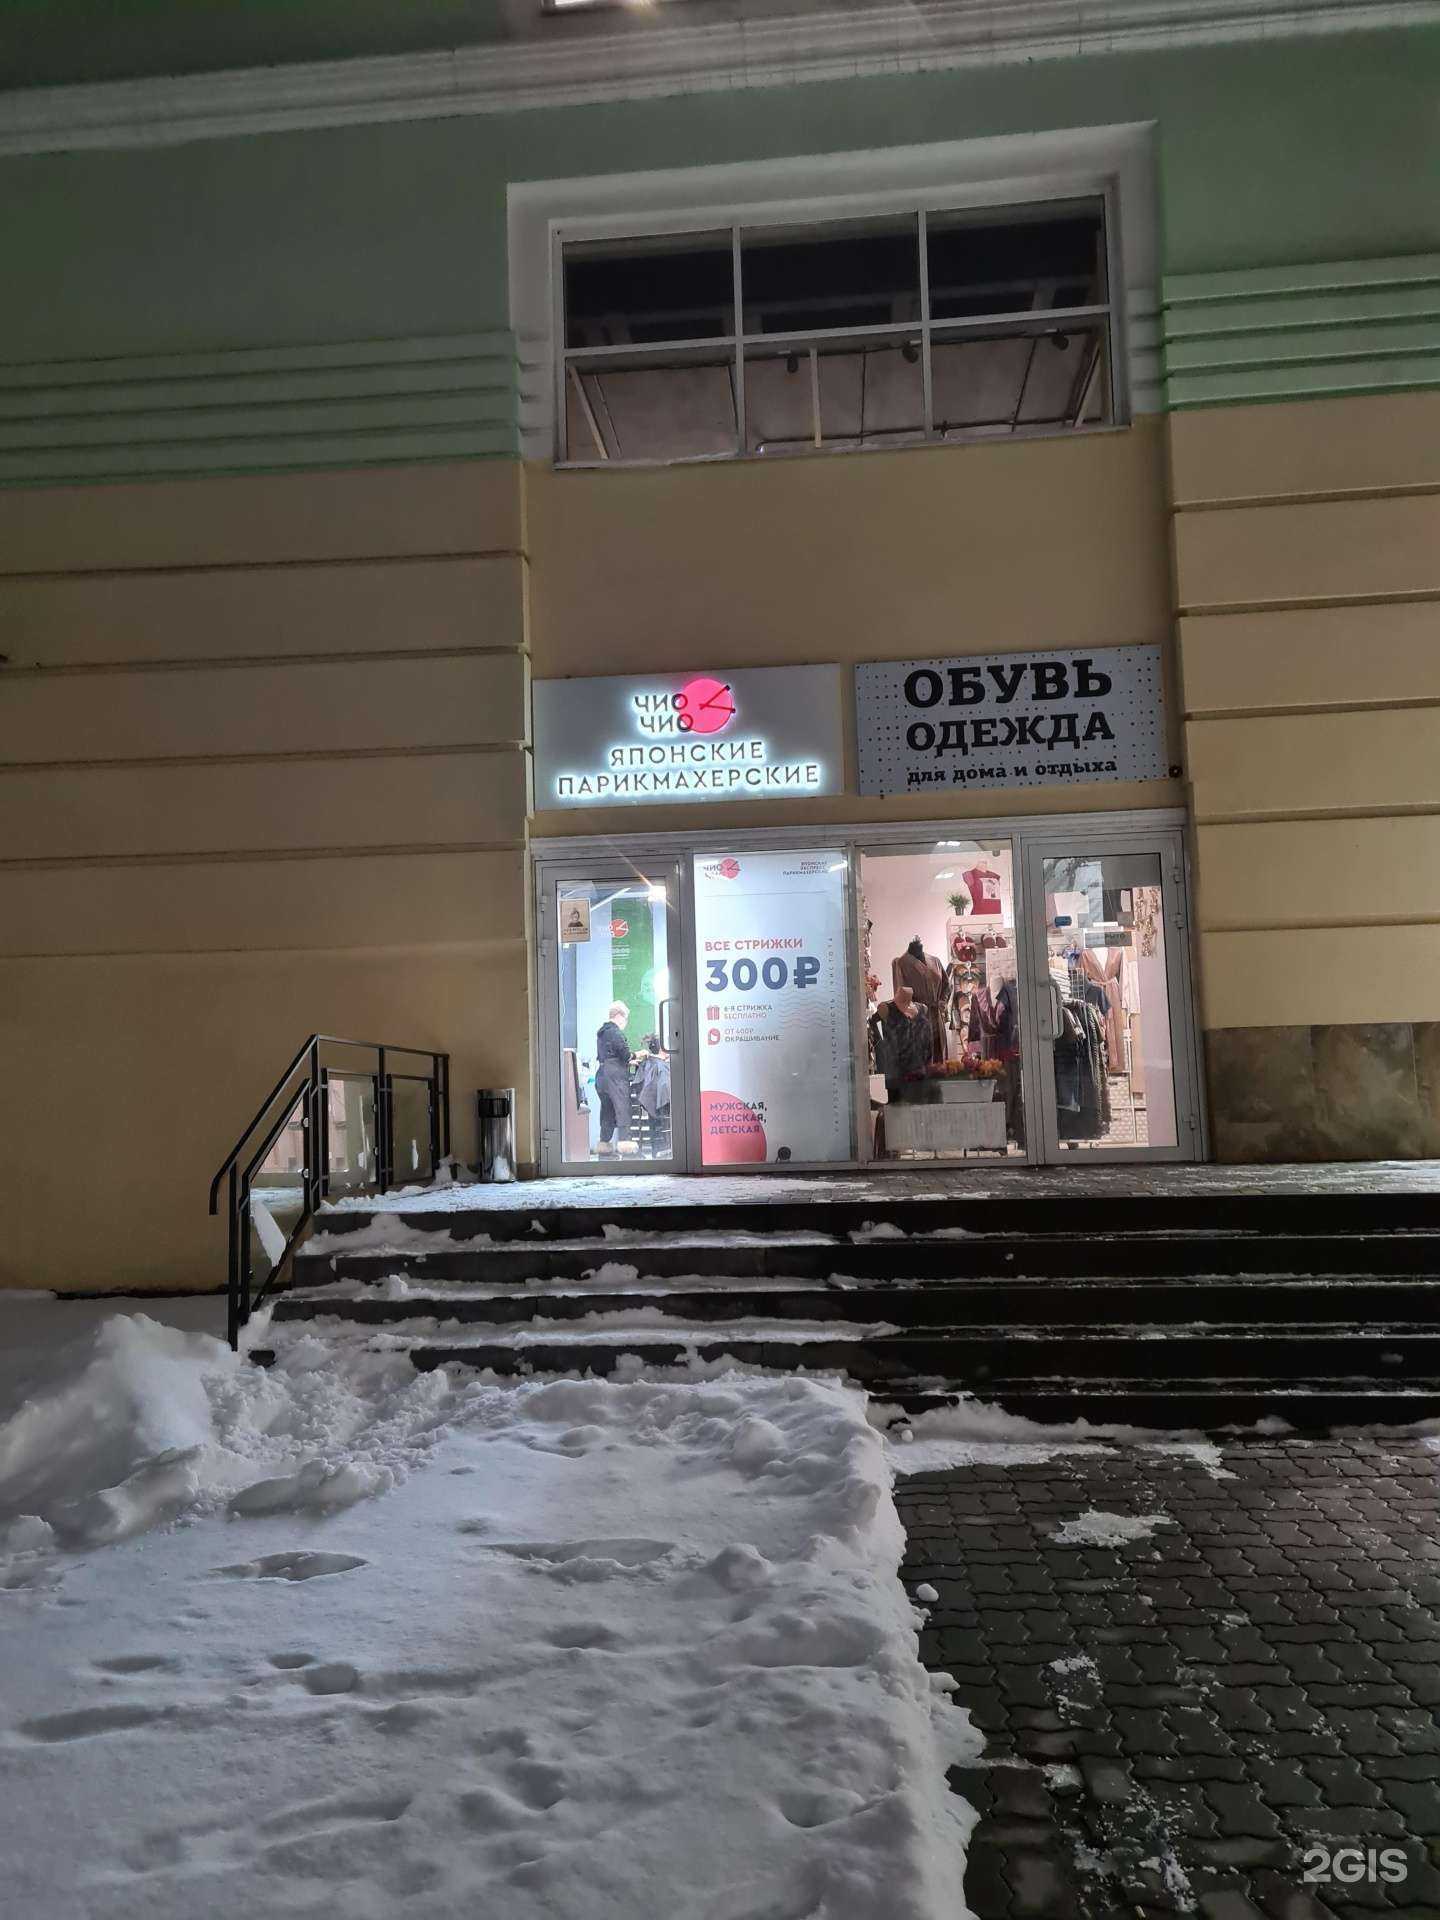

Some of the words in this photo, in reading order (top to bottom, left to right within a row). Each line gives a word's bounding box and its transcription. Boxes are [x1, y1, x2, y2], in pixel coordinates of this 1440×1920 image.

[904, 658, 1112, 708] ОБУВЬ
[634, 692, 688, 713] ЧИО
[640, 713, 694, 733] ЧИО
[906, 711, 1115, 758] ОДЕЖДА
[611, 741, 763, 766] ЯПОНСКИЕ
[558, 765, 819, 795] ПАРИКМАХЕРСКИЕ
[907, 768, 946, 785] для
[952, 764, 1006, 783] дома
[1014, 764, 1027, 776] и
[1035, 759, 1117, 778] отдыха
[705, 941, 731, 951] ВСЕ
[734, 938, 802, 950] СТРИЖКИ
[705, 956, 821, 992] 300₽
[737, 1004, 773, 1012] СТРИЖКА
[725, 1034, 780, 1042] ОКРАШИВАНИЕ
[710, 1102, 767, 1111] МУЖСКАЯ,
[710, 1113, 767, 1123] ЖЕНСКАЯ,
[710, 1124, 760, 1135] ДЕТСКАЯ
